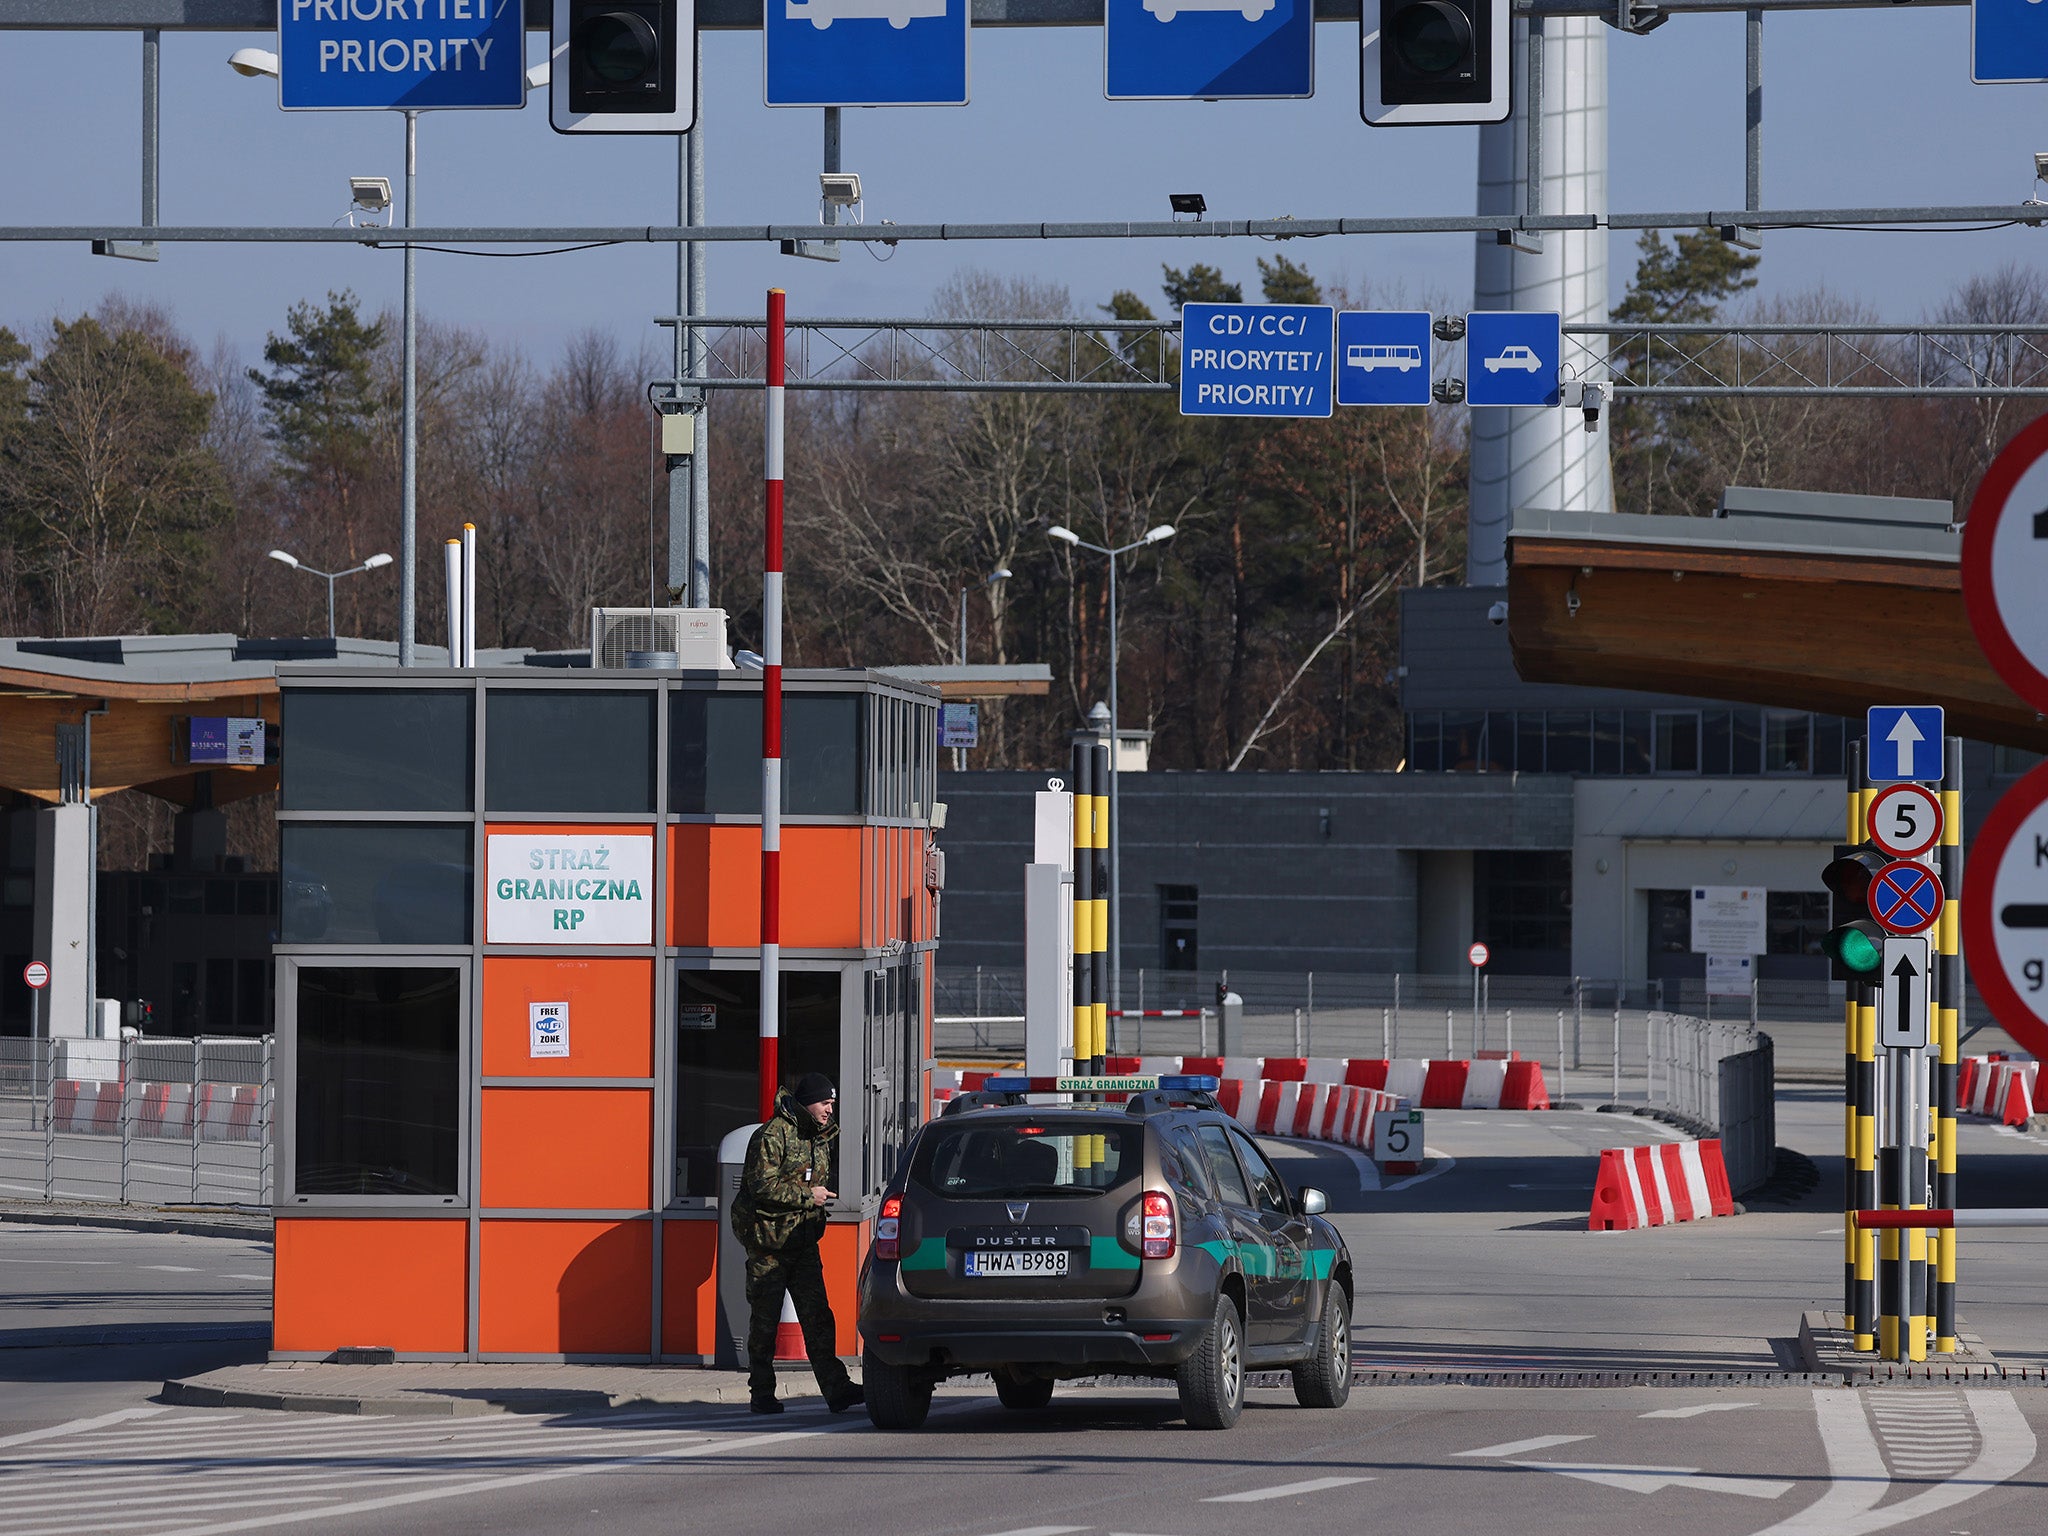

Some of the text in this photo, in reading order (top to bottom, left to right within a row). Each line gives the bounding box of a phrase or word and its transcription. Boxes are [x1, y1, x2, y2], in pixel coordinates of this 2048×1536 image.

[319, 38, 494, 73] PRIORITY
[1198, 383, 1314, 406] PRIORITY/
[1894, 804, 1917, 839] 5
[529, 843, 610, 870] STRAŻ
[496, 878, 642, 900] GRANICZNA
[553, 908, 585, 930] RP
[540, 1007, 559, 1016] FREE
[540, 1035, 560, 1043] ZONE
[1060, 1078, 1155, 1090] STRAŻ GRANICZNA
[1387, 1119, 1410, 1154] 5
[976, 1236, 1057, 1246] DUSTER
[976, 1252, 1066, 1271] HWA B988
